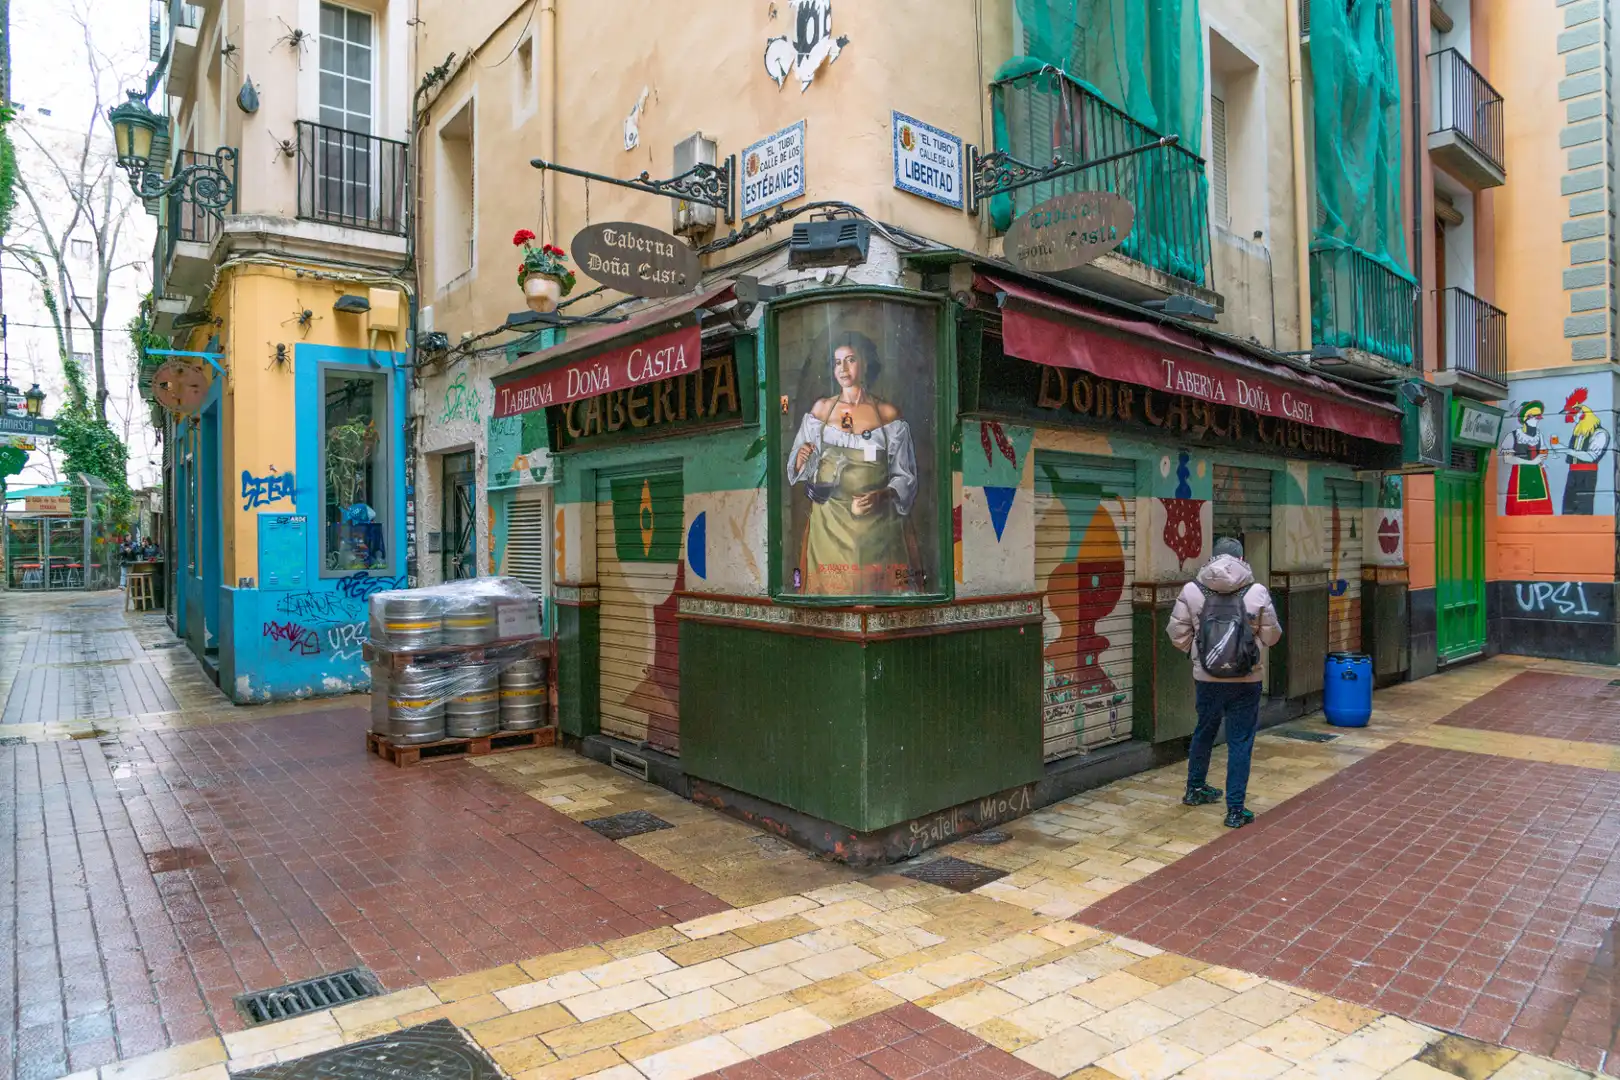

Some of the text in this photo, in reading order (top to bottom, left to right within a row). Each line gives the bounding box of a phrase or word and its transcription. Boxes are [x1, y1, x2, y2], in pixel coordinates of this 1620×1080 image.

[760, 145, 800, 173] CALLE DE LOS
[919, 147, 955, 169] CALLE DE LA
[745, 164, 800, 205] ESTÉBANES
[905, 158, 953, 193] LIBERTAD
[602, 228, 675, 258] Taberna
[587, 252, 630, 277] Doña
[502, 382, 553, 415] TABERNA
[567, 363, 610, 399] DOÑA
[627, 344, 687, 382] CASTA
[1162, 358, 1314, 423] TABERNA DOÑA CASTA
